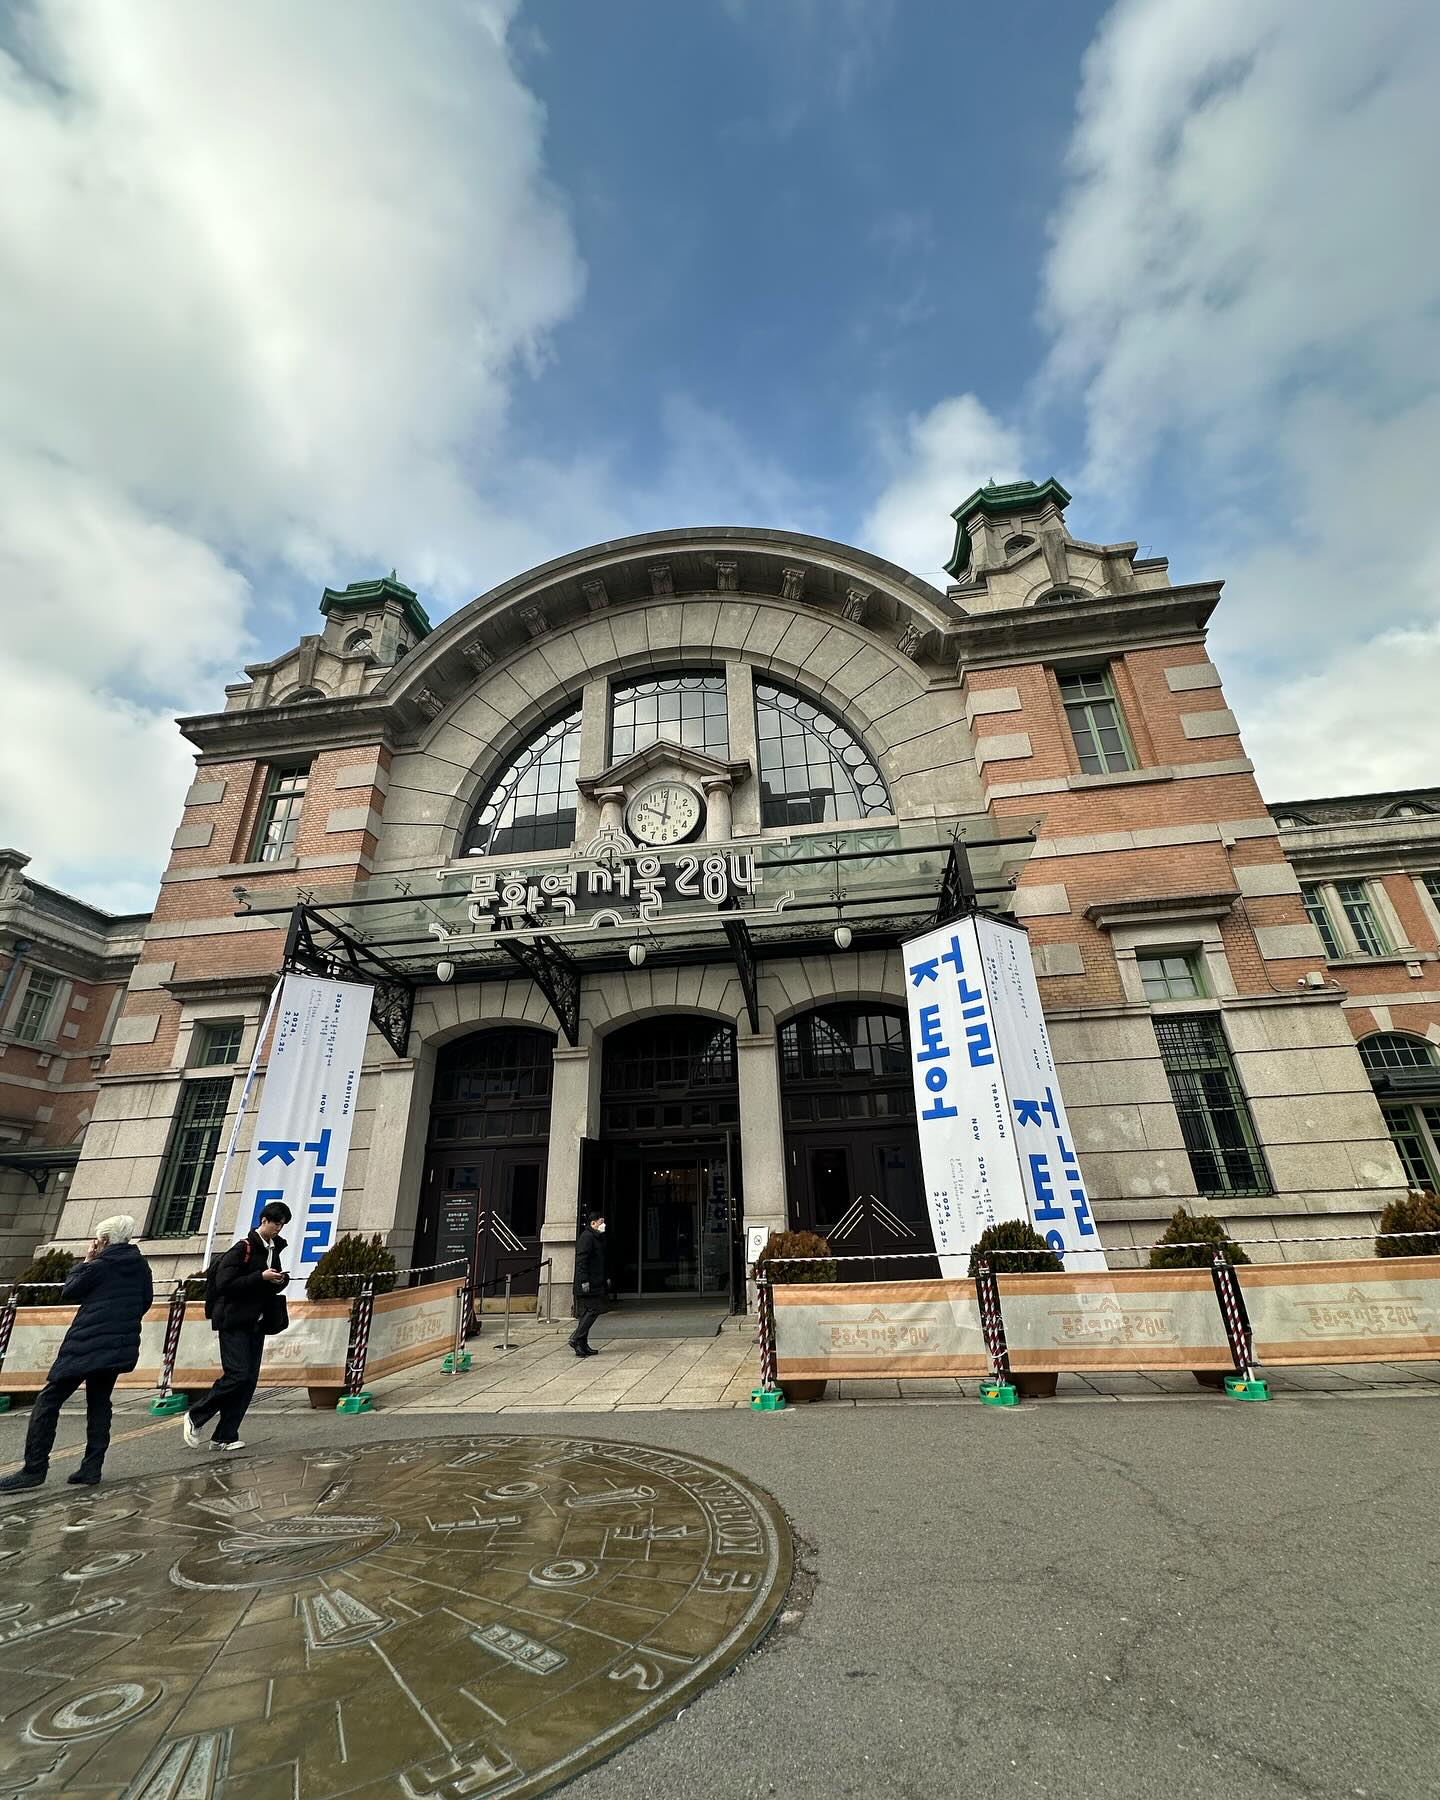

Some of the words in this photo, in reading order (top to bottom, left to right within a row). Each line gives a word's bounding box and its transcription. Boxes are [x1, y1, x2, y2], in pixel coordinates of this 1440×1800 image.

[640, 803, 648, 811] 10
[682, 799, 688, 807] 2
[687, 809, 693, 817] 3
[672, 829, 678, 837] 5
[681, 820, 687, 828] 4
[661, 833, 667, 841] 6
[675, 854, 763, 905] 284
[334, 994, 342, 1013] 2024
[289, 1012, 299, 1036] 2024.
[342, 1070, 355, 1115] TRADITION
[991, 1083, 1005, 1139] TRADITION
[971, 1118, 980, 1141] NOW
[978, 1156, 987, 1184] 2024
[941, 1191, 951, 1222] 2024.
